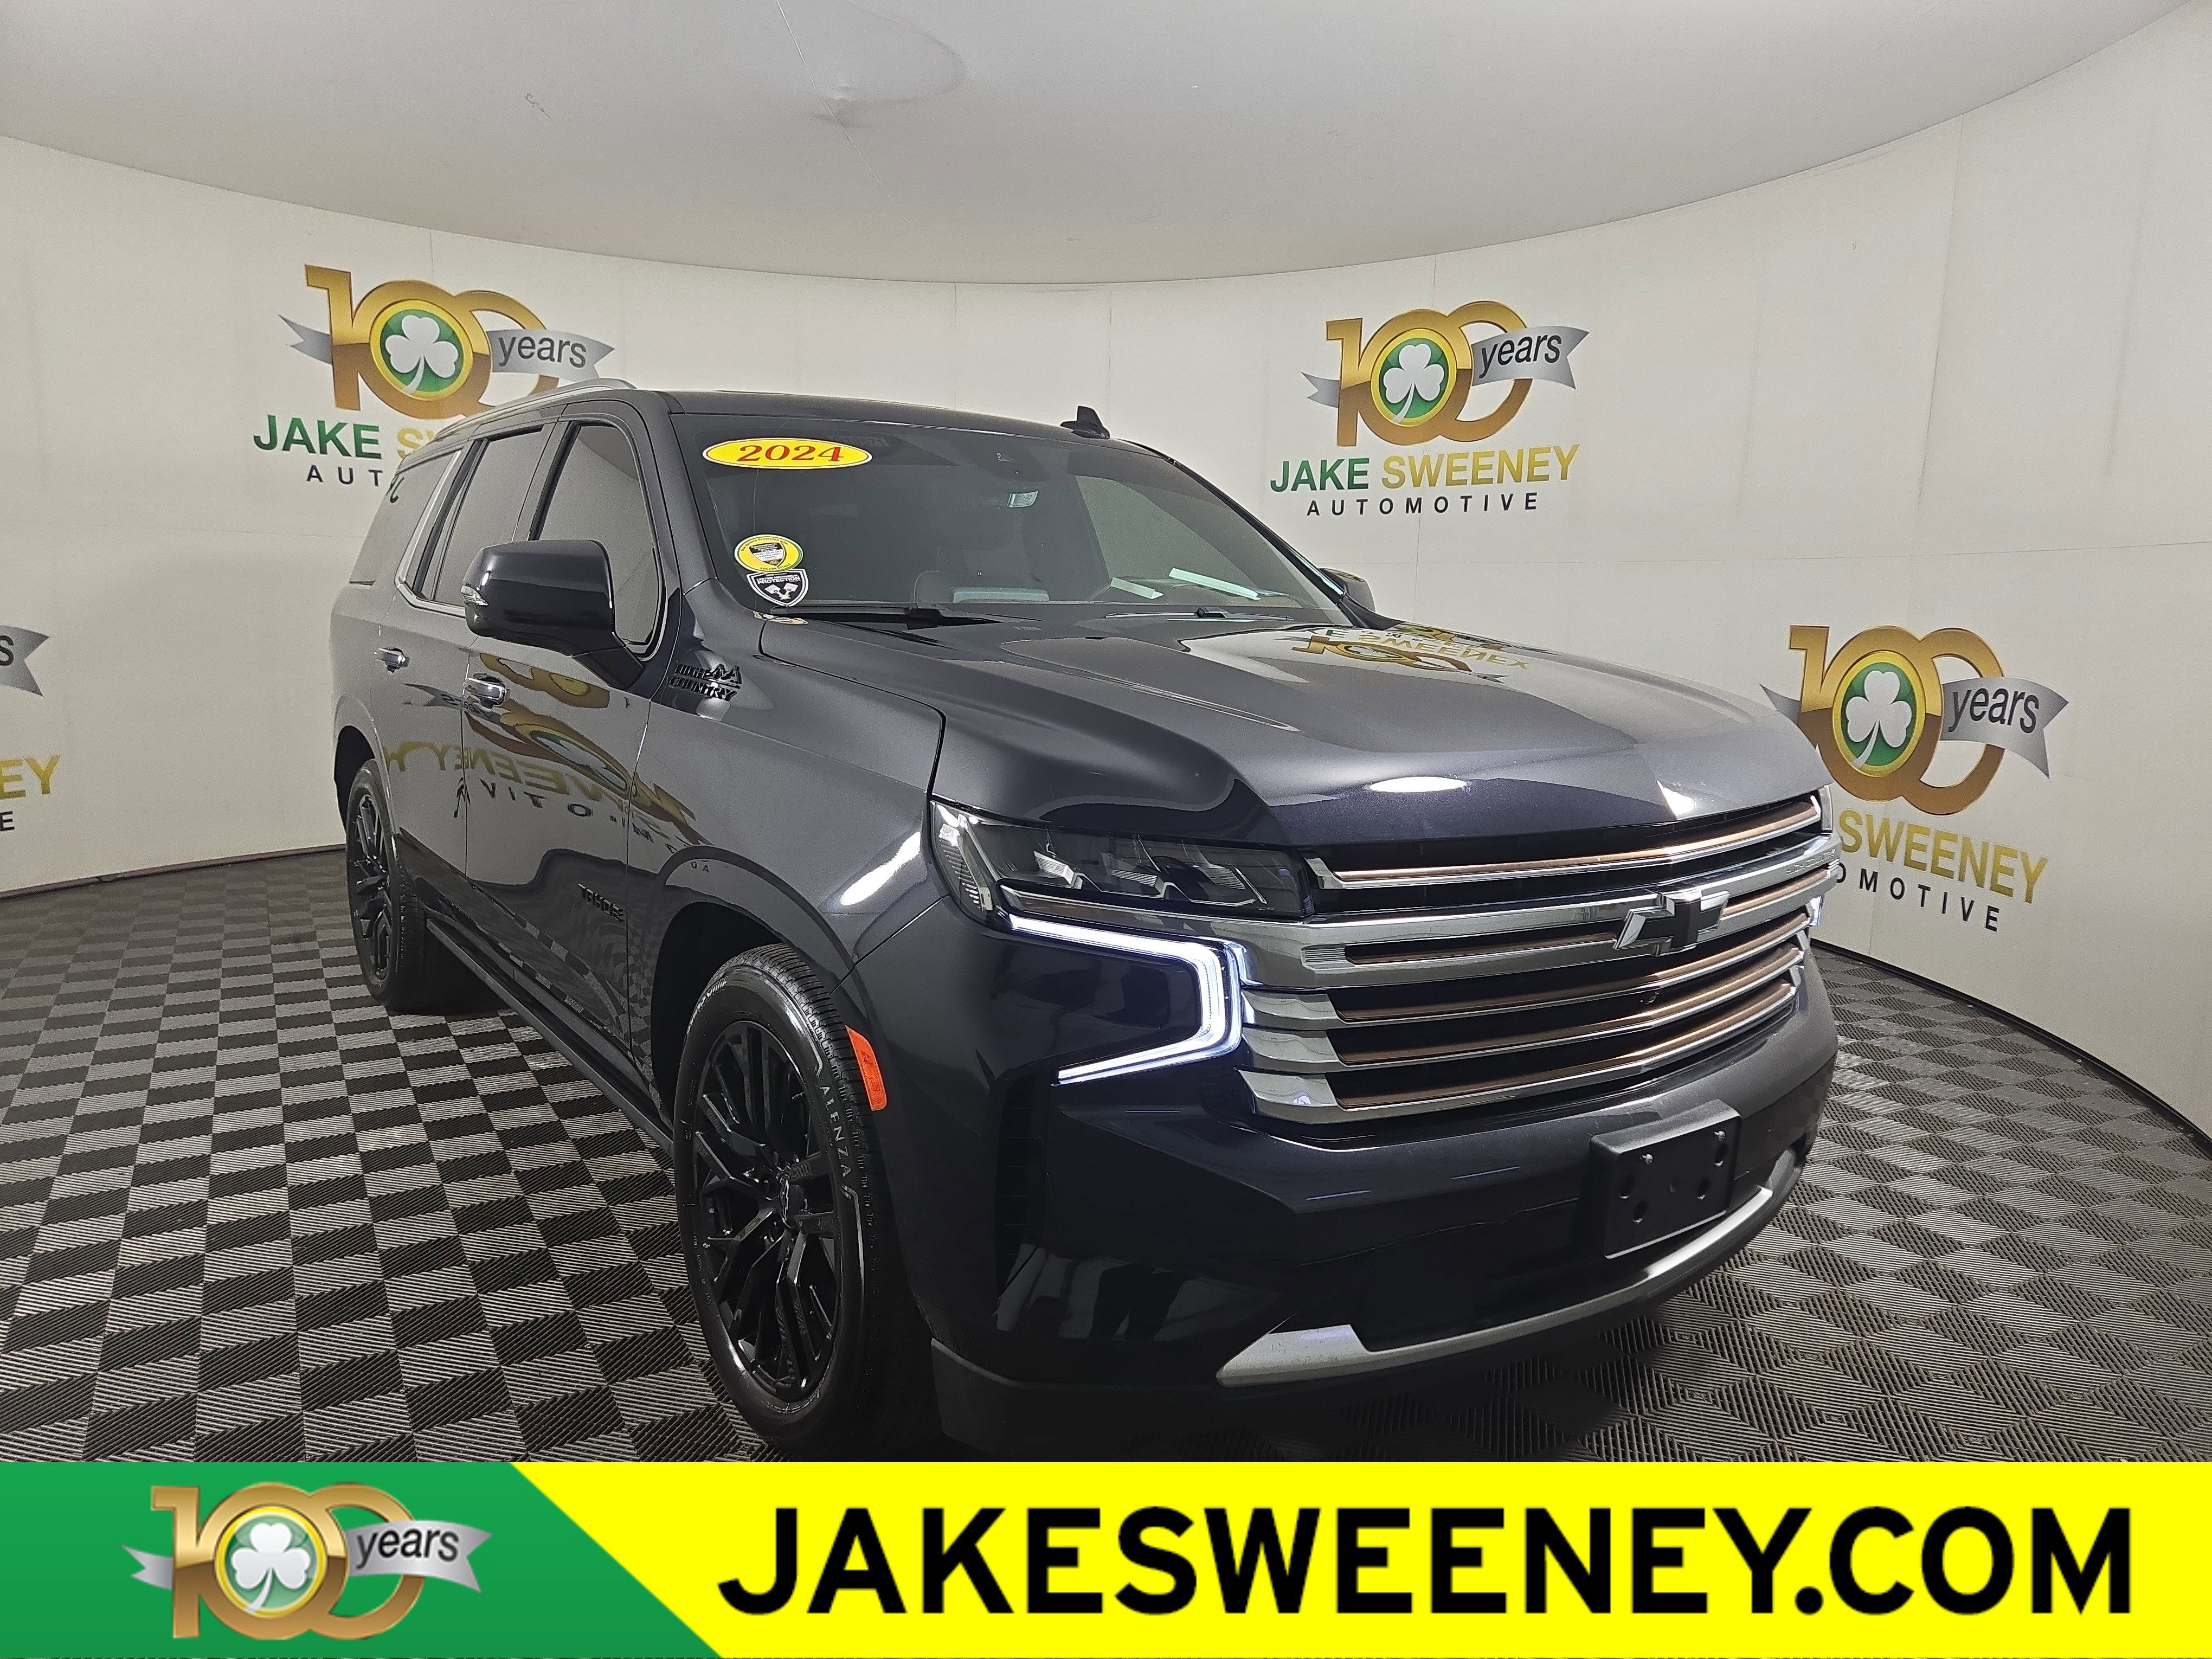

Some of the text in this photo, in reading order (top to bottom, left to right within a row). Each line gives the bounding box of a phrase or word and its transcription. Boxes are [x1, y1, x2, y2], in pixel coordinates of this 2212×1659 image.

[499, 333, 587, 369] years
[1326, 300, 1562, 446] 100 years
[253, 415, 382, 460] JAKE
[736, 445, 844, 462] 2024
[1270, 444, 1580, 492] JAKE SWEENEY
[1307, 492, 1538, 516] AUTOMOTIVE
[757, 576, 801, 584] PROTECTION
[1947, 687, 2040, 734] years
[1838, 809, 2048, 904] SWEENEY
[820, 1086, 852, 1178] ALENZA
